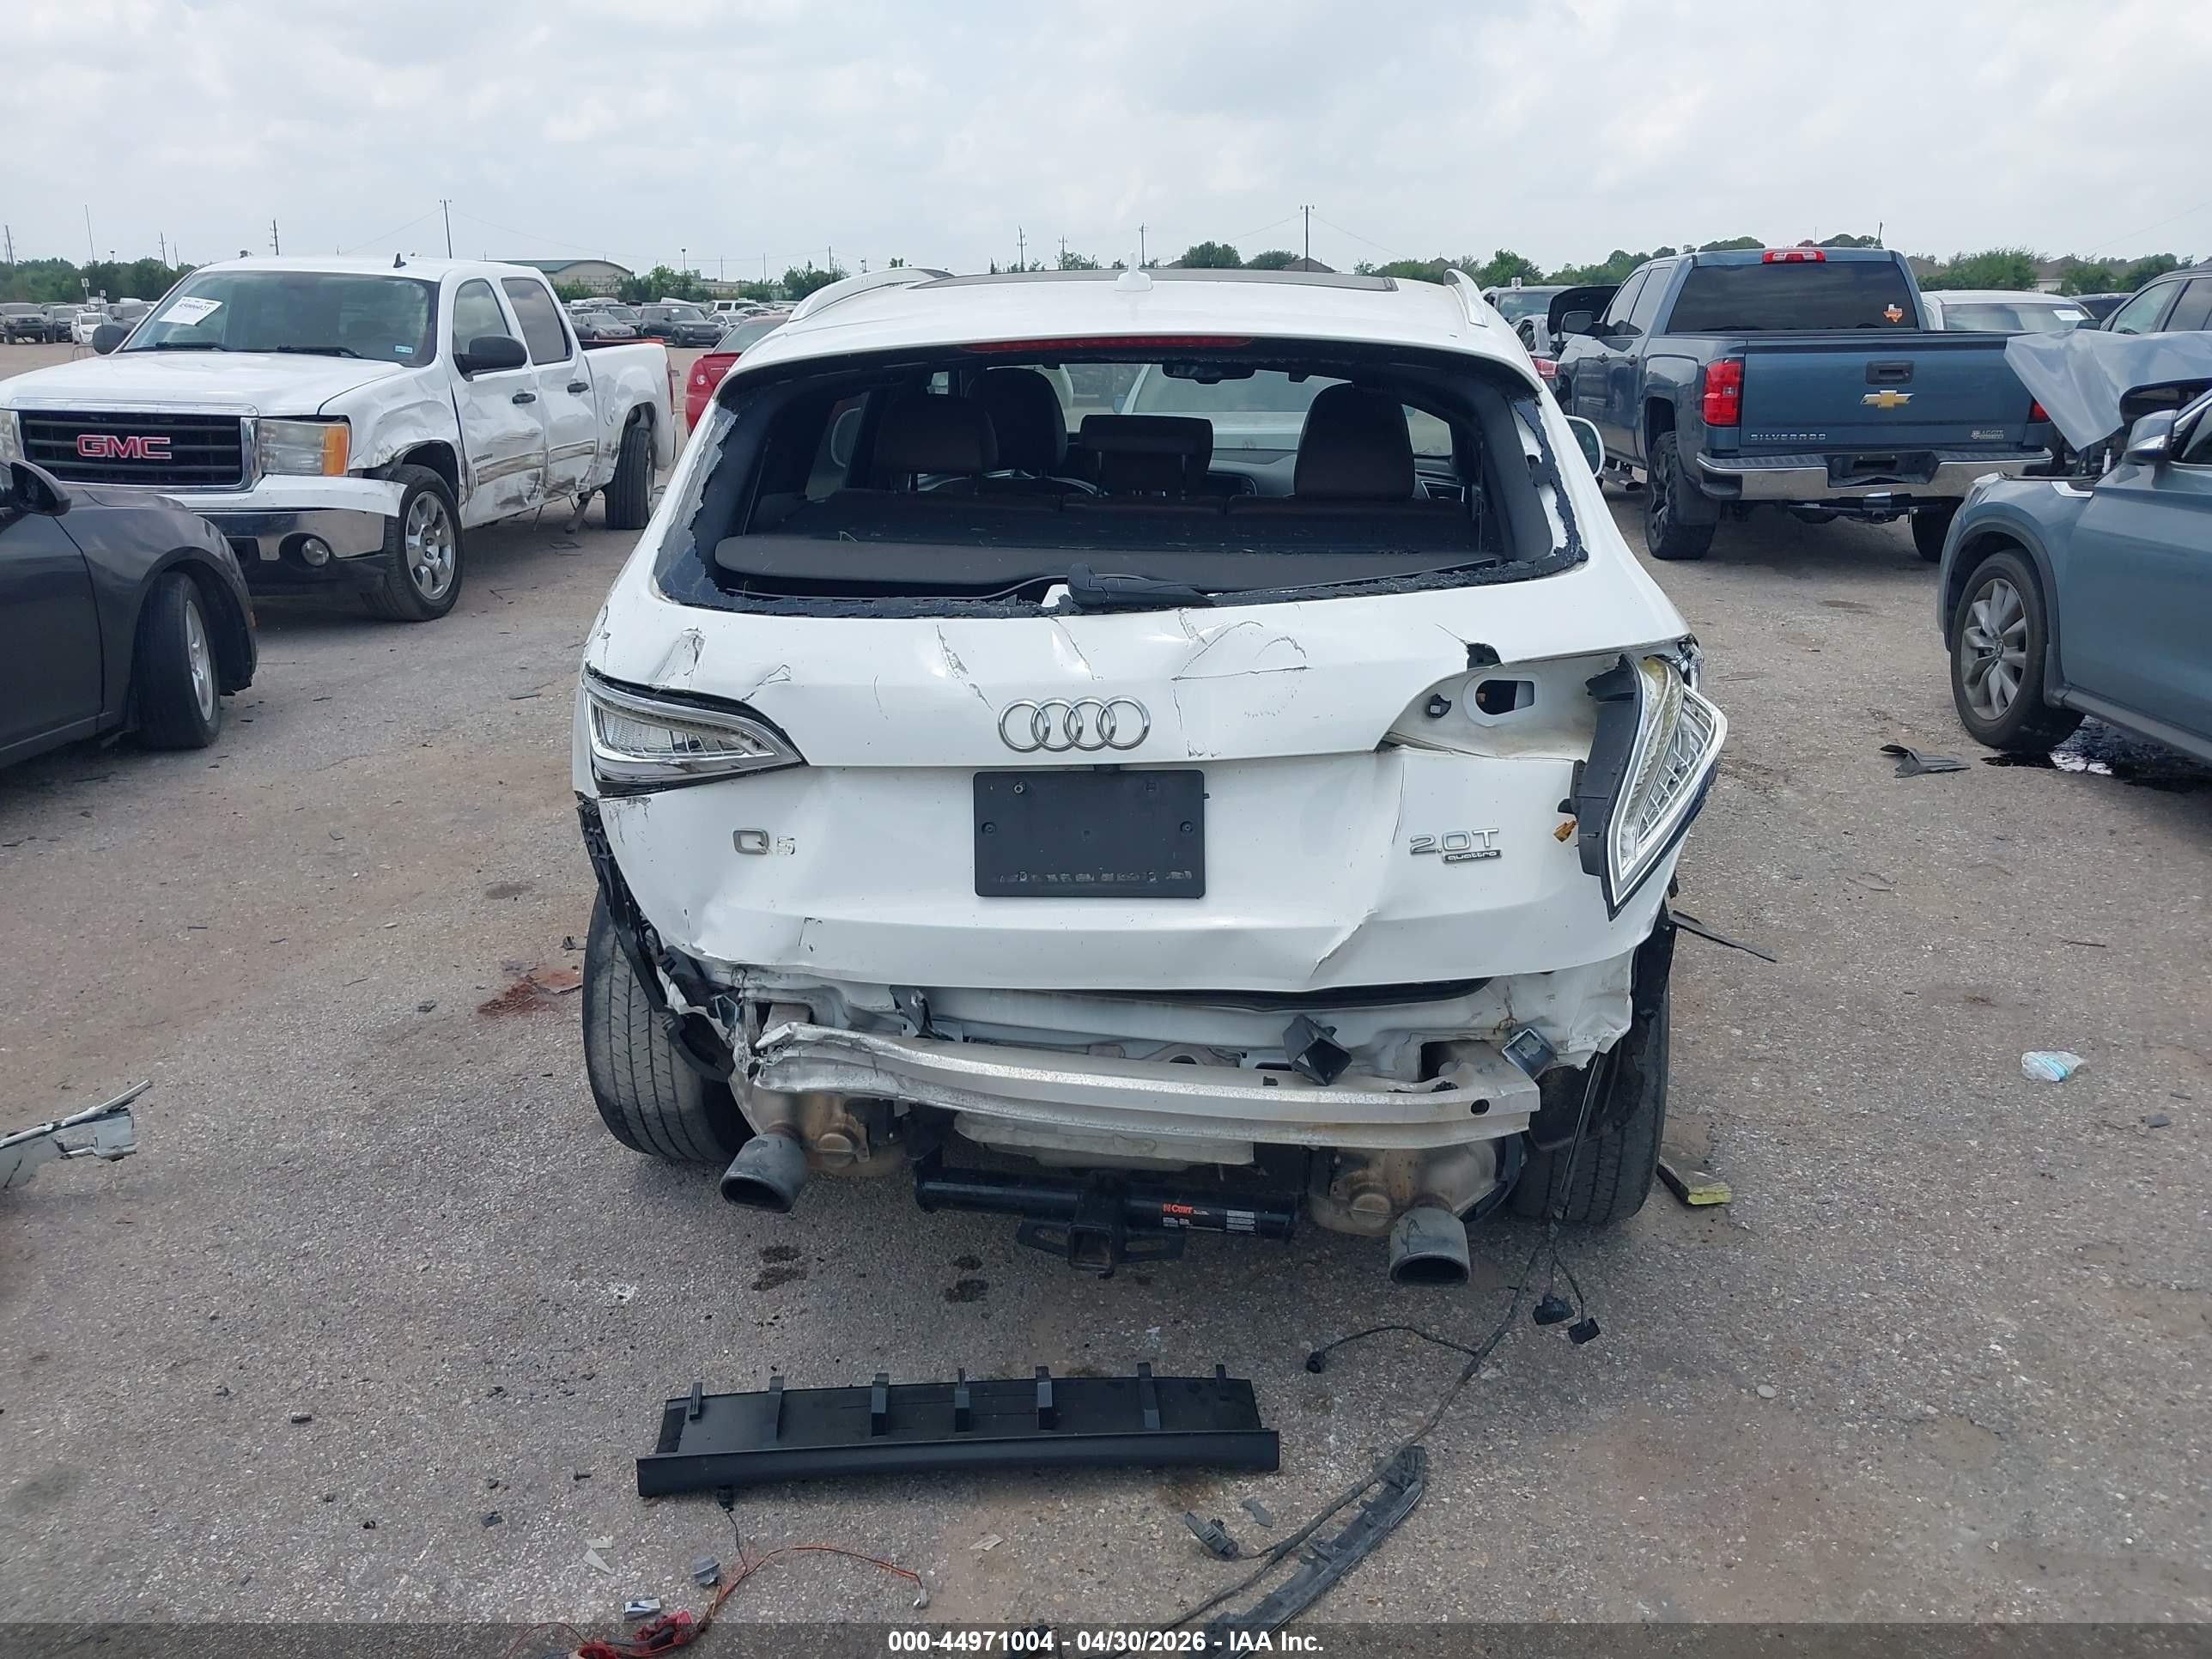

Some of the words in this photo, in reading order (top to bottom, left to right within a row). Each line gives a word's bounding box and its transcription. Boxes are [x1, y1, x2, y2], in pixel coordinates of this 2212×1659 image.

[76, 434, 173, 459] GMC
[1410, 828, 1499, 855] 2.0T
[1447, 850, 1498, 861] quattro
